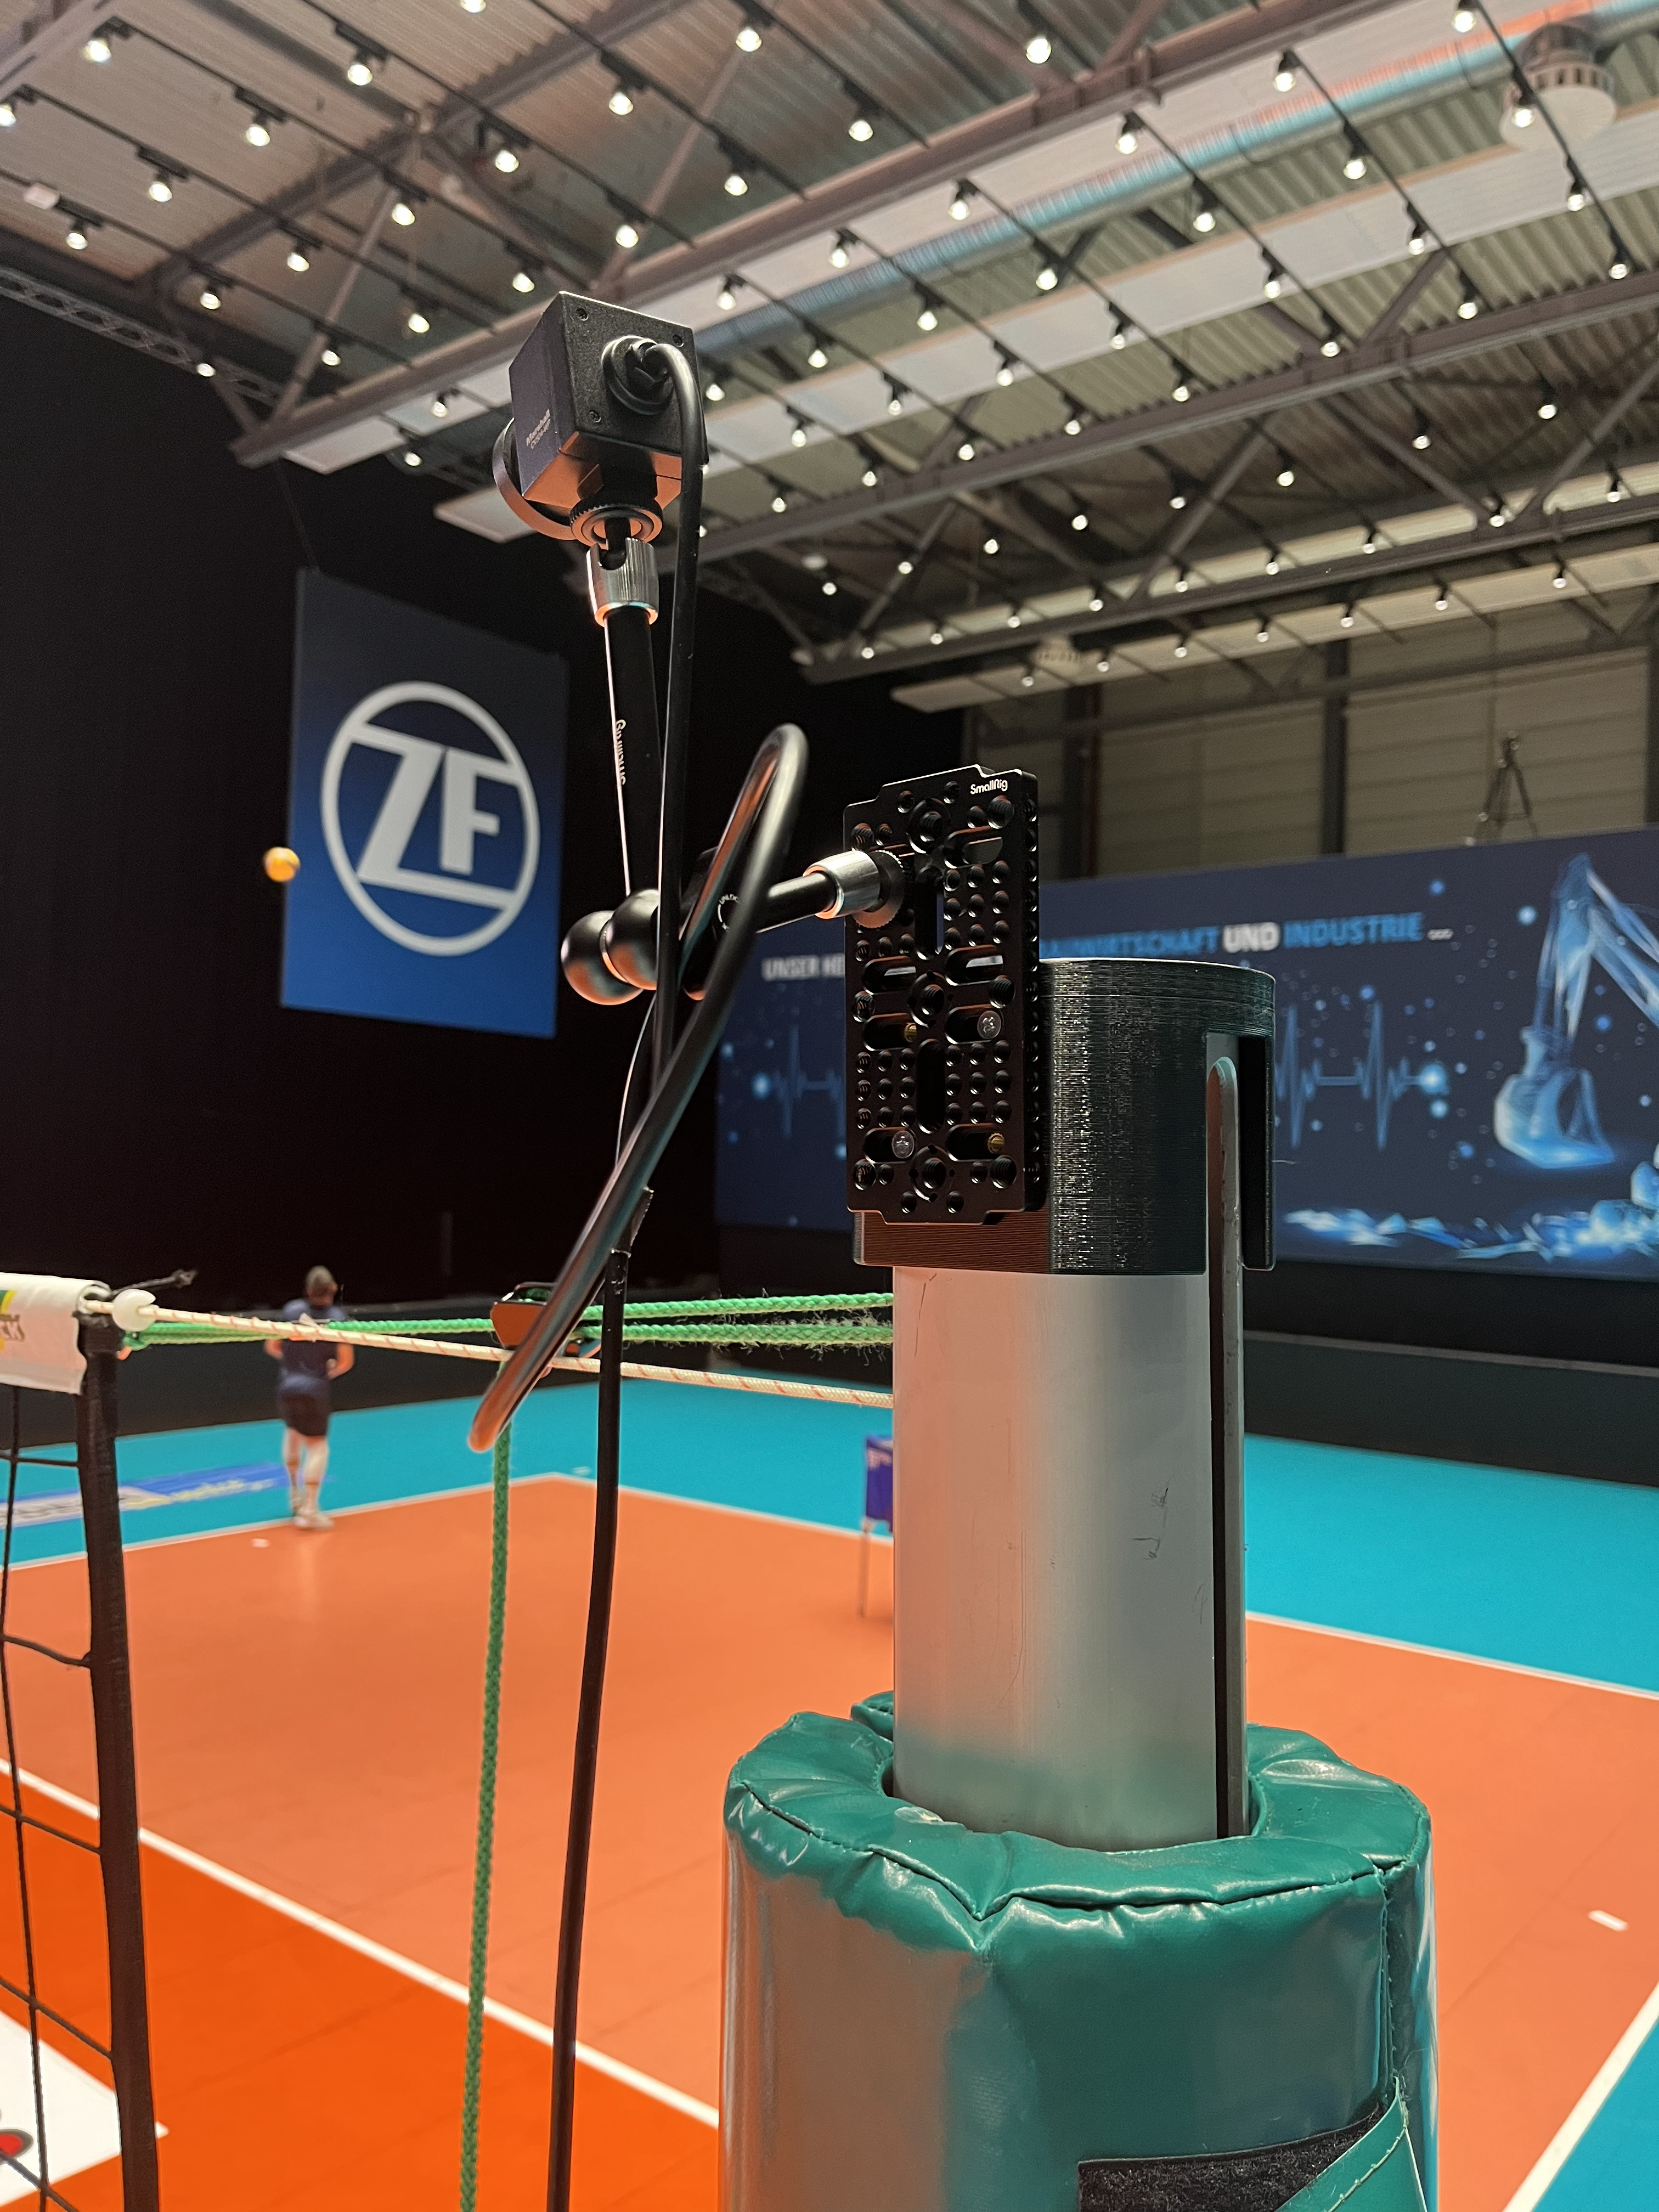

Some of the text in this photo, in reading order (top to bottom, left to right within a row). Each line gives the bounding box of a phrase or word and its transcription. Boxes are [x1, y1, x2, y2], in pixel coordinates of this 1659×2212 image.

[970, 778, 1008, 794] SmallRig
[1223, 922, 1280, 952] UND
[1283, 912, 1424, 949] INDUSTRIE
